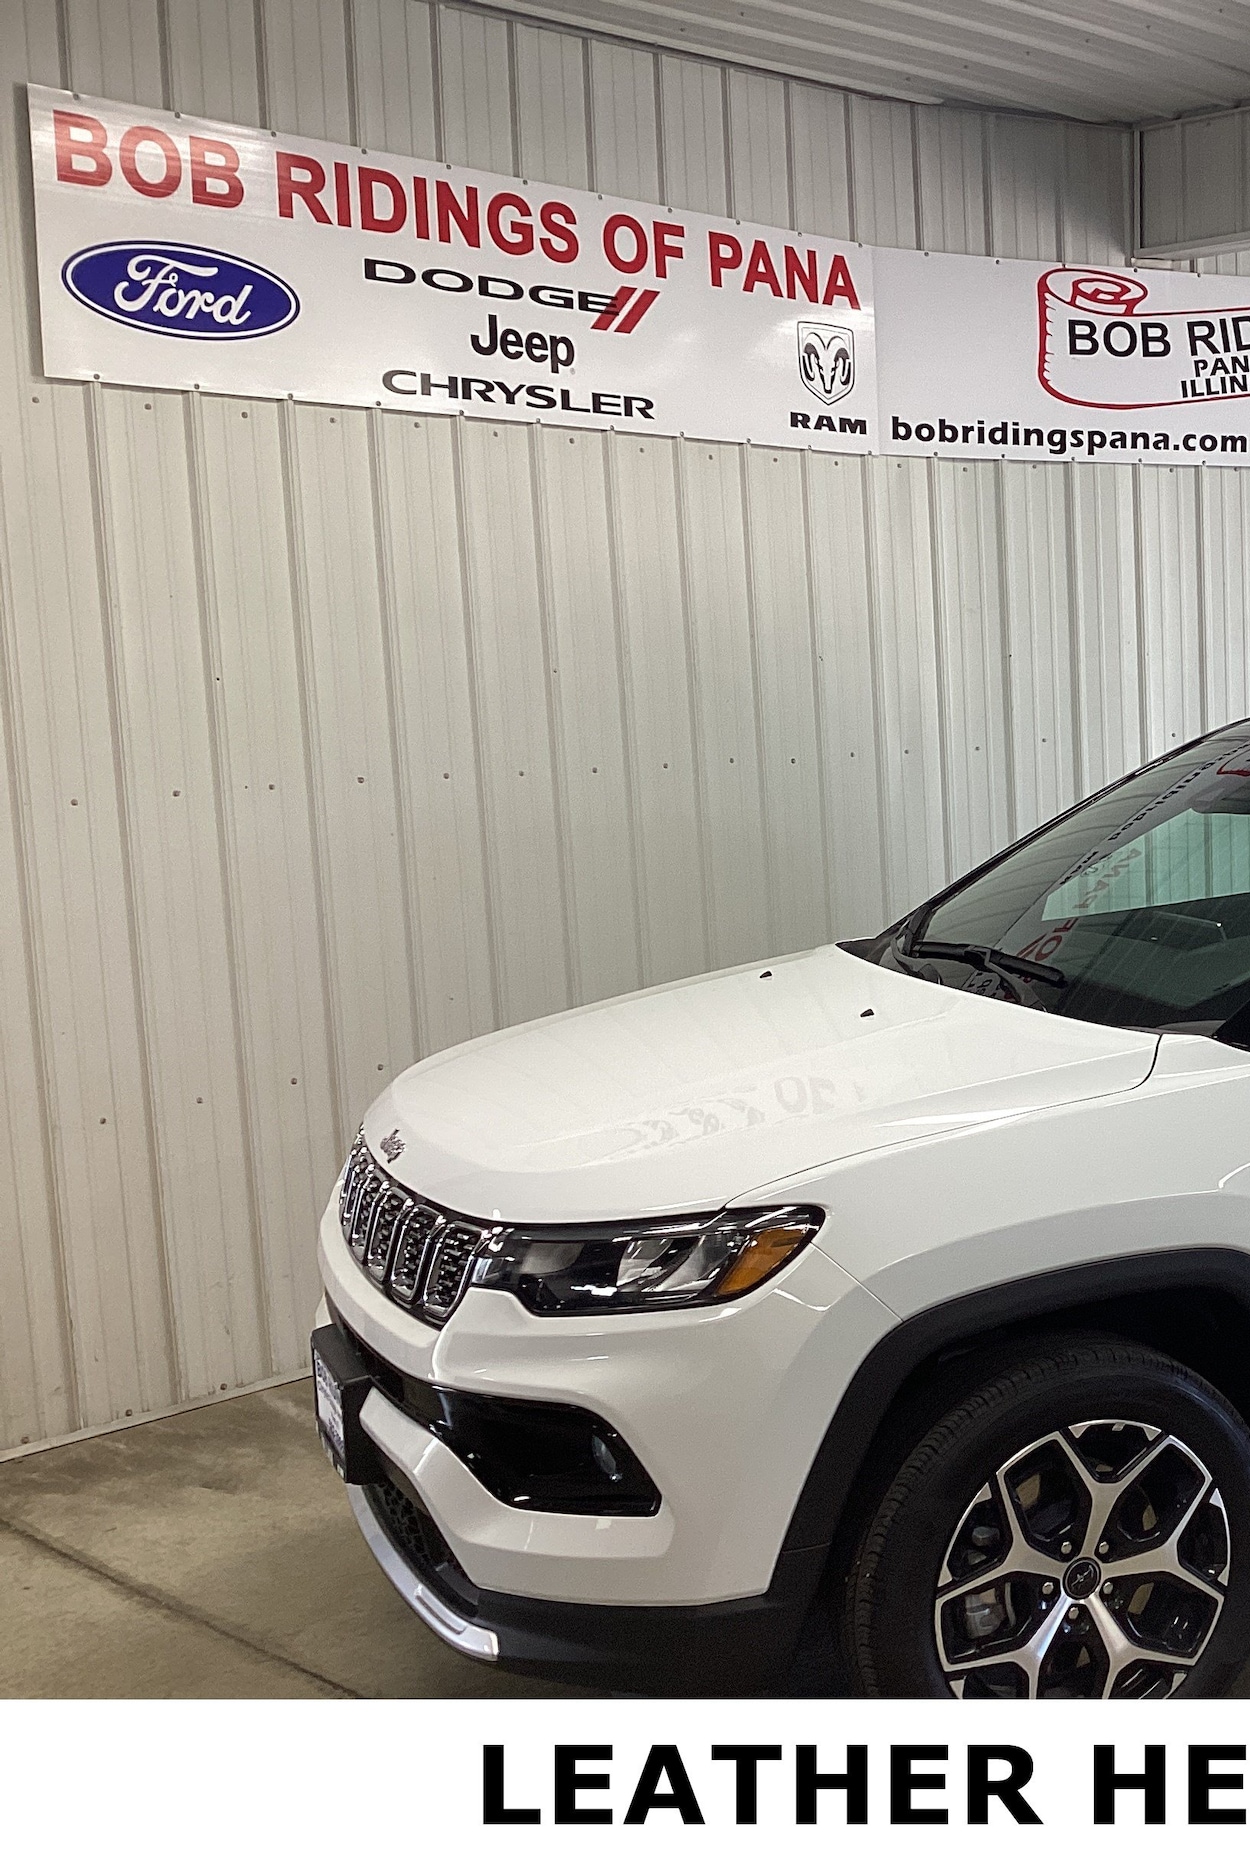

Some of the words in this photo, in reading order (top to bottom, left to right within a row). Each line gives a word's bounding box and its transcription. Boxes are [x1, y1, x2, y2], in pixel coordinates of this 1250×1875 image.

[53, 109, 245, 210] BOB
[275, 151, 580, 265] RIDINGS
[601, 213, 686, 280] OF
[707, 230, 861, 311] PANA
[114, 254, 253, 325] Ford
[364, 258, 621, 317] DODGE
[470, 313, 575, 374] Jeep
[1068, 319, 1171, 358] BOB
[381, 369, 655, 420] CHRYSLER
[789, 411, 868, 435] RAM
[891, 415, 1248, 456] bobridingspana.com
